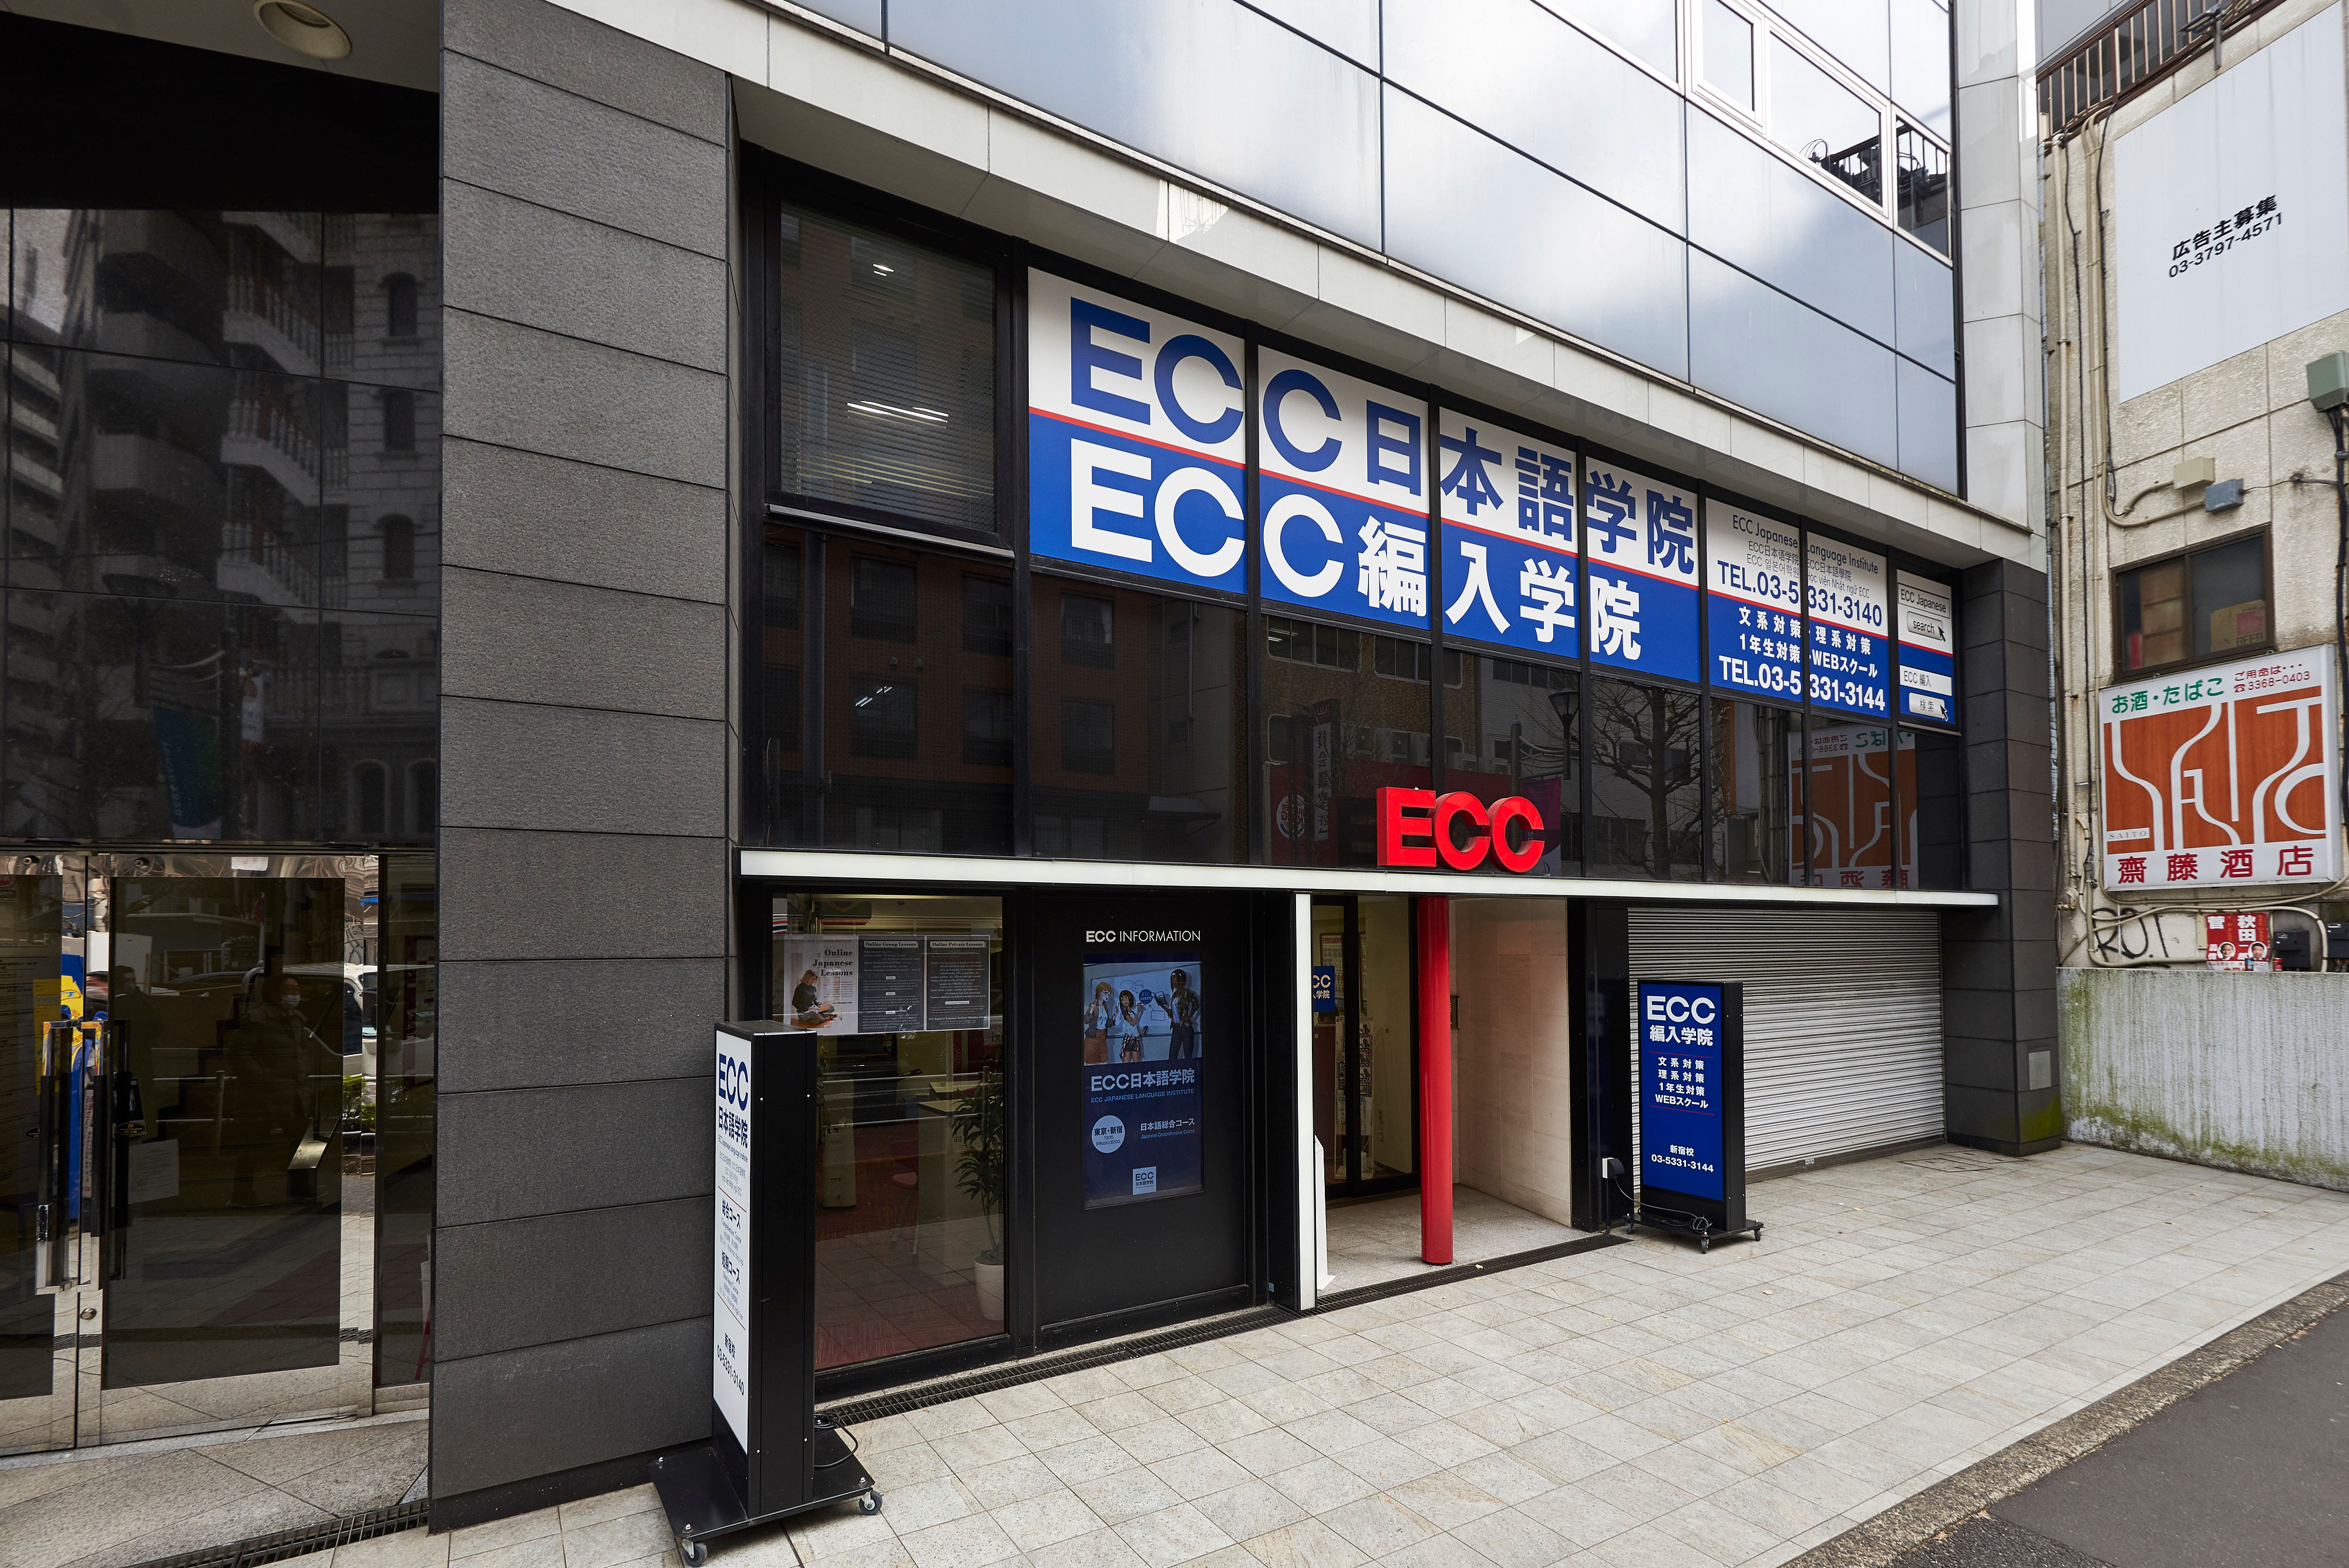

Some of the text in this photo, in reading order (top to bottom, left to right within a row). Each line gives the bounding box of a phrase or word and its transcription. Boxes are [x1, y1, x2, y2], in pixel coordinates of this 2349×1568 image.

[2172, 194, 2277, 261] 広告主募集
[2169, 212, 2282, 278] 03-3797-4571
[1733, 514, 1753, 534] ECC
[1755, 522, 1799, 549] Japanese
[1849, 553, 1879, 574] Institute
[1747, 553, 1762, 567] ECC
[1859, 587, 1870, 598] ECC
[1900, 589, 1947, 613] ECC Japanese
[1913, 619, 1935, 635] search
[1904, 670, 1918, 684] ECC
[2112, 677, 2225, 715] お酒・たばこ
[1377, 786, 1545, 873] ECC
[2108, 829, 2148, 841] SAITO
[1086, 930, 1201, 943] ECC INFORMATION
[812, 959, 853, 968] Japanese
[1313, 974, 1331, 988] CC
[1647, 995, 1716, 1025] ECC
[1649, 1024, 1714, 1047] 編入学院
[1658, 1056, 1705, 1071] 文系対策
[718, 1053, 749, 1111] ECC
[1091, 1068, 1196, 1092] ECC日本語学院
[1658, 1069, 1705, 1084] 理系対策
[1104, 1094, 1134, 1102] JAPANESE
[1135, 1091, 1166, 1099] LANGUAGE
[1166, 1088, 1195, 1096] INSTITUTE
[1659, 1082, 1705, 1097] 1年生対策
[1655, 1093, 1709, 1109] WEBスクール
[718, 1106, 748, 1149] 日本語学院
[1093, 1125, 1123, 1136] 東京・新宿
[1140, 1117, 1195, 1132] 日本語総合コース
[1669, 1143, 1694, 1157] 新宿校
[1651, 1153, 1714, 1173] 03-5331-3144
[1135, 1172, 1154, 1181] ECC
[717, 1344, 745, 1396] 03-5331-3140
